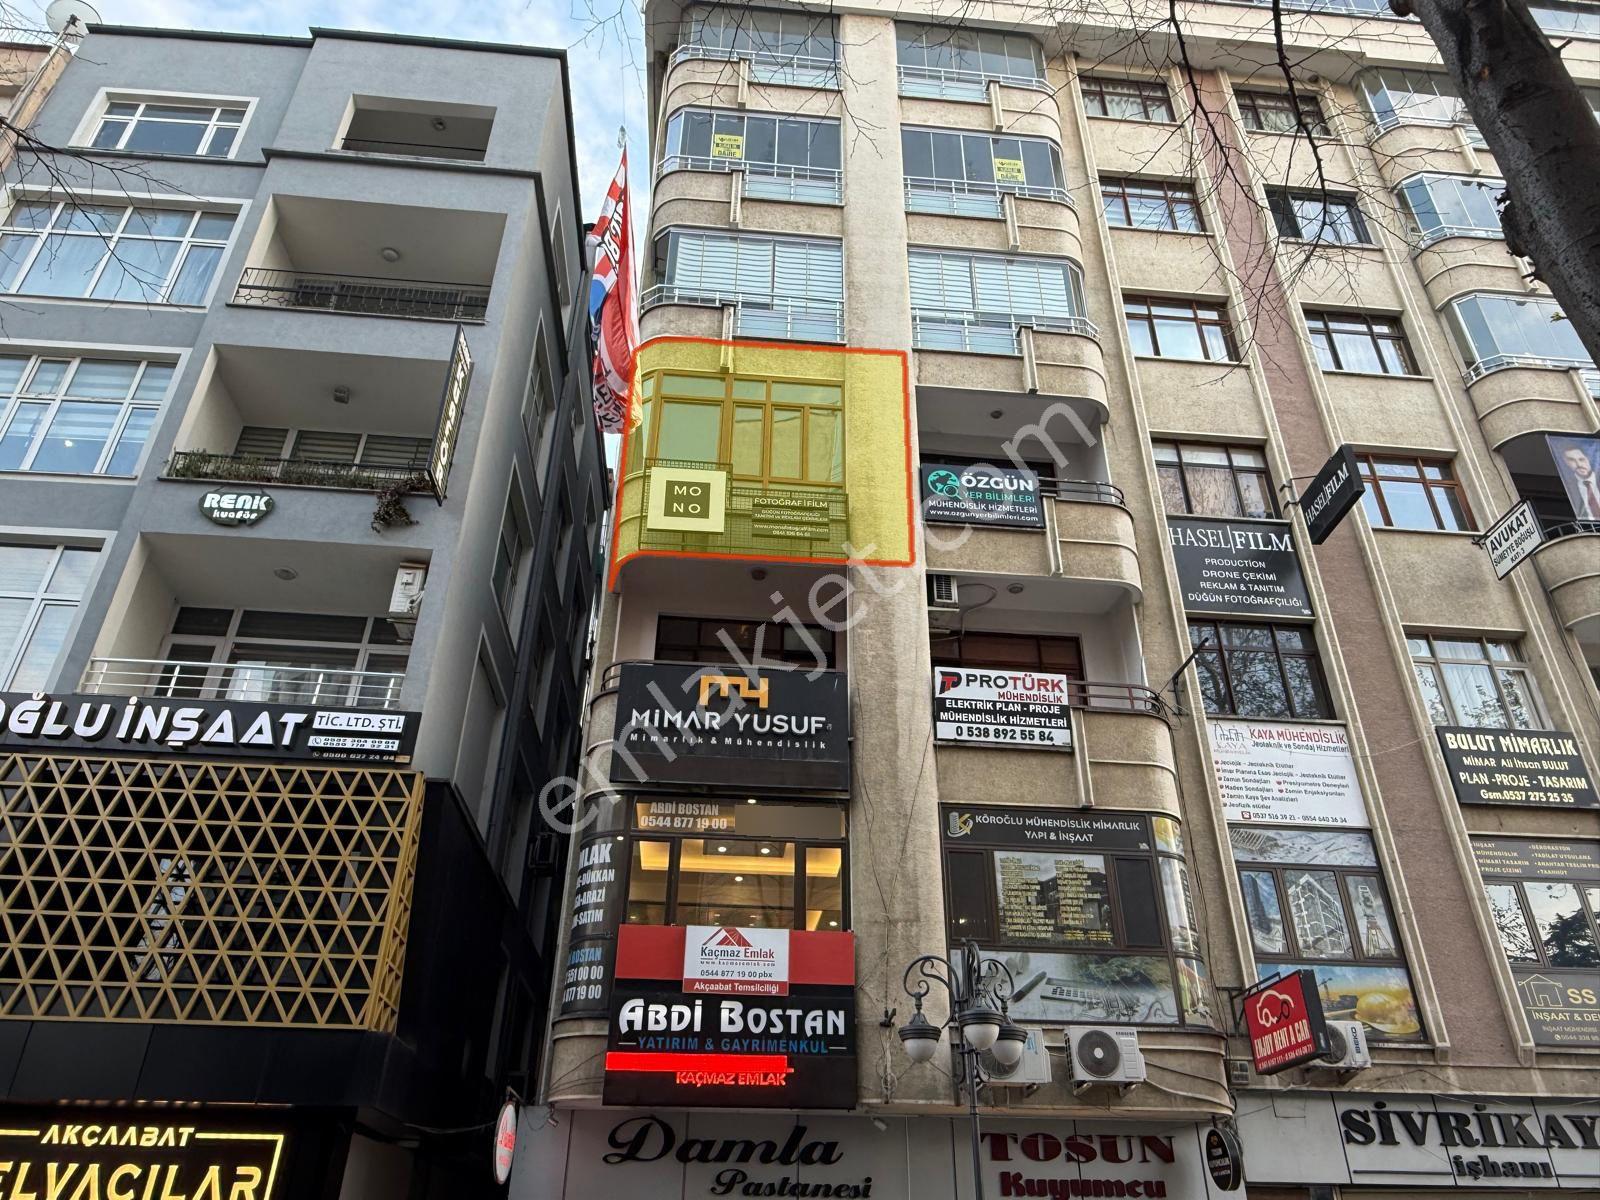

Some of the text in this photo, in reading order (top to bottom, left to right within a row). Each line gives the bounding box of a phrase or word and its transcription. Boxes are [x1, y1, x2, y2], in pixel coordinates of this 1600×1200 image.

[961, 472, 1034, 491] ÖZGÜN
[674, 485, 702, 497] MO
[963, 491, 1035, 503] YER BİLİMLERİ
[1305, 462, 1350, 526] HASEL FILM
[203, 493, 270, 511] RENK
[673, 502, 701, 514] NO
[928, 499, 1038, 514] MÜHENDİSLİK HİZMETLERİ
[1168, 527, 1295, 552] HASEL FILM
[1489, 509, 1529, 555] AVUKAT
[1202, 569, 1277, 581] DRONE ÇEKİMİ
[1200, 581, 1285, 593] REKLAM & TANITIM
[1188, 592, 1303, 607] DÜĞÜN FOTOĞRAFÇILIĞI
[965, 673, 1065, 694] PROTÜRK
[997, 690, 1063, 704] MÜHENDİSLİK
[945, 699, 1061, 714] ELEKTRİK PLAN PROJE
[0, 691, 309, 748] ĞLU İNŞAAT
[317, 714, 343, 726] TİC.
[346, 717, 375, 728] LTD.
[630, 708, 827, 735] MİMAR YUSUF
[939, 711, 1067, 727] MÜHENDİSLİK HİZMETLERİ
[955, 725, 1054, 743] 0 538 892 55 84
[1249, 728, 1348, 745] KAYA MÜHENDİSLİK
[710, 736, 718, 744] &
[724, 736, 827, 749] Mühendislik
[1292, 742, 1316, 753] Sondaj
[1445, 732, 1578, 756] BULUT MİMARLIK
[1462, 755, 1497, 768] MİMAR
[1514, 757, 1541, 769] İhsan
[1541, 760, 1569, 770] BULUT
[1459, 771, 1490, 785] PLAN
[1537, 775, 1589, 790] TASARIM
[1528, 792, 1546, 801] 275
[1548, 793, 1560, 802] 25
[1560, 793, 1575, 803] 35
[650, 801, 719, 816] ABDİ BOSTAN
[640, 815, 728, 830] 0544 877 19 00
[975, 813, 1141, 831] KÖROĞLU MÜHENDİSLİK MİMARLIK
[1024, 829, 1094, 843] YAPI & İNŞAAT
[700, 946, 775, 960] Kaçmaz Emlak
[590, 965, 604, 980] 00
[700, 969, 719, 977] 0544
[737, 970, 747, 978] 19
[758, 971, 773, 979] pbx
[576, 984, 602, 1000] 19 00
[693, 981, 779, 994] Akçaabat Temsilciliği
[1566, 988, 1597, 1005] SS
[618, 998, 846, 1038] ABDİ BOSTAN
[1531, 1009, 1600, 1022] İNŞAAT & DE
[638, 1036, 829, 1054] YATIRIM & GAYRİMENKUL
[1254, 1033, 1274, 1059] ENJOY
[1272, 1026, 1290, 1052] RENT
[1288, 1024, 1297, 1046] A
[1294, 1019, 1311, 1043] CAR
[675, 1071, 787, 1087] KAÇMAZ EMLAK
[40, 1124, 196, 1148] AKÇAABAT
[602, 1115, 845, 1166] Damla
[980, 1131, 1177, 1164] TOSUN
[709, 1168, 873, 1199] Pastanesi
[999, 1170, 1167, 1200] Kuyumcu
